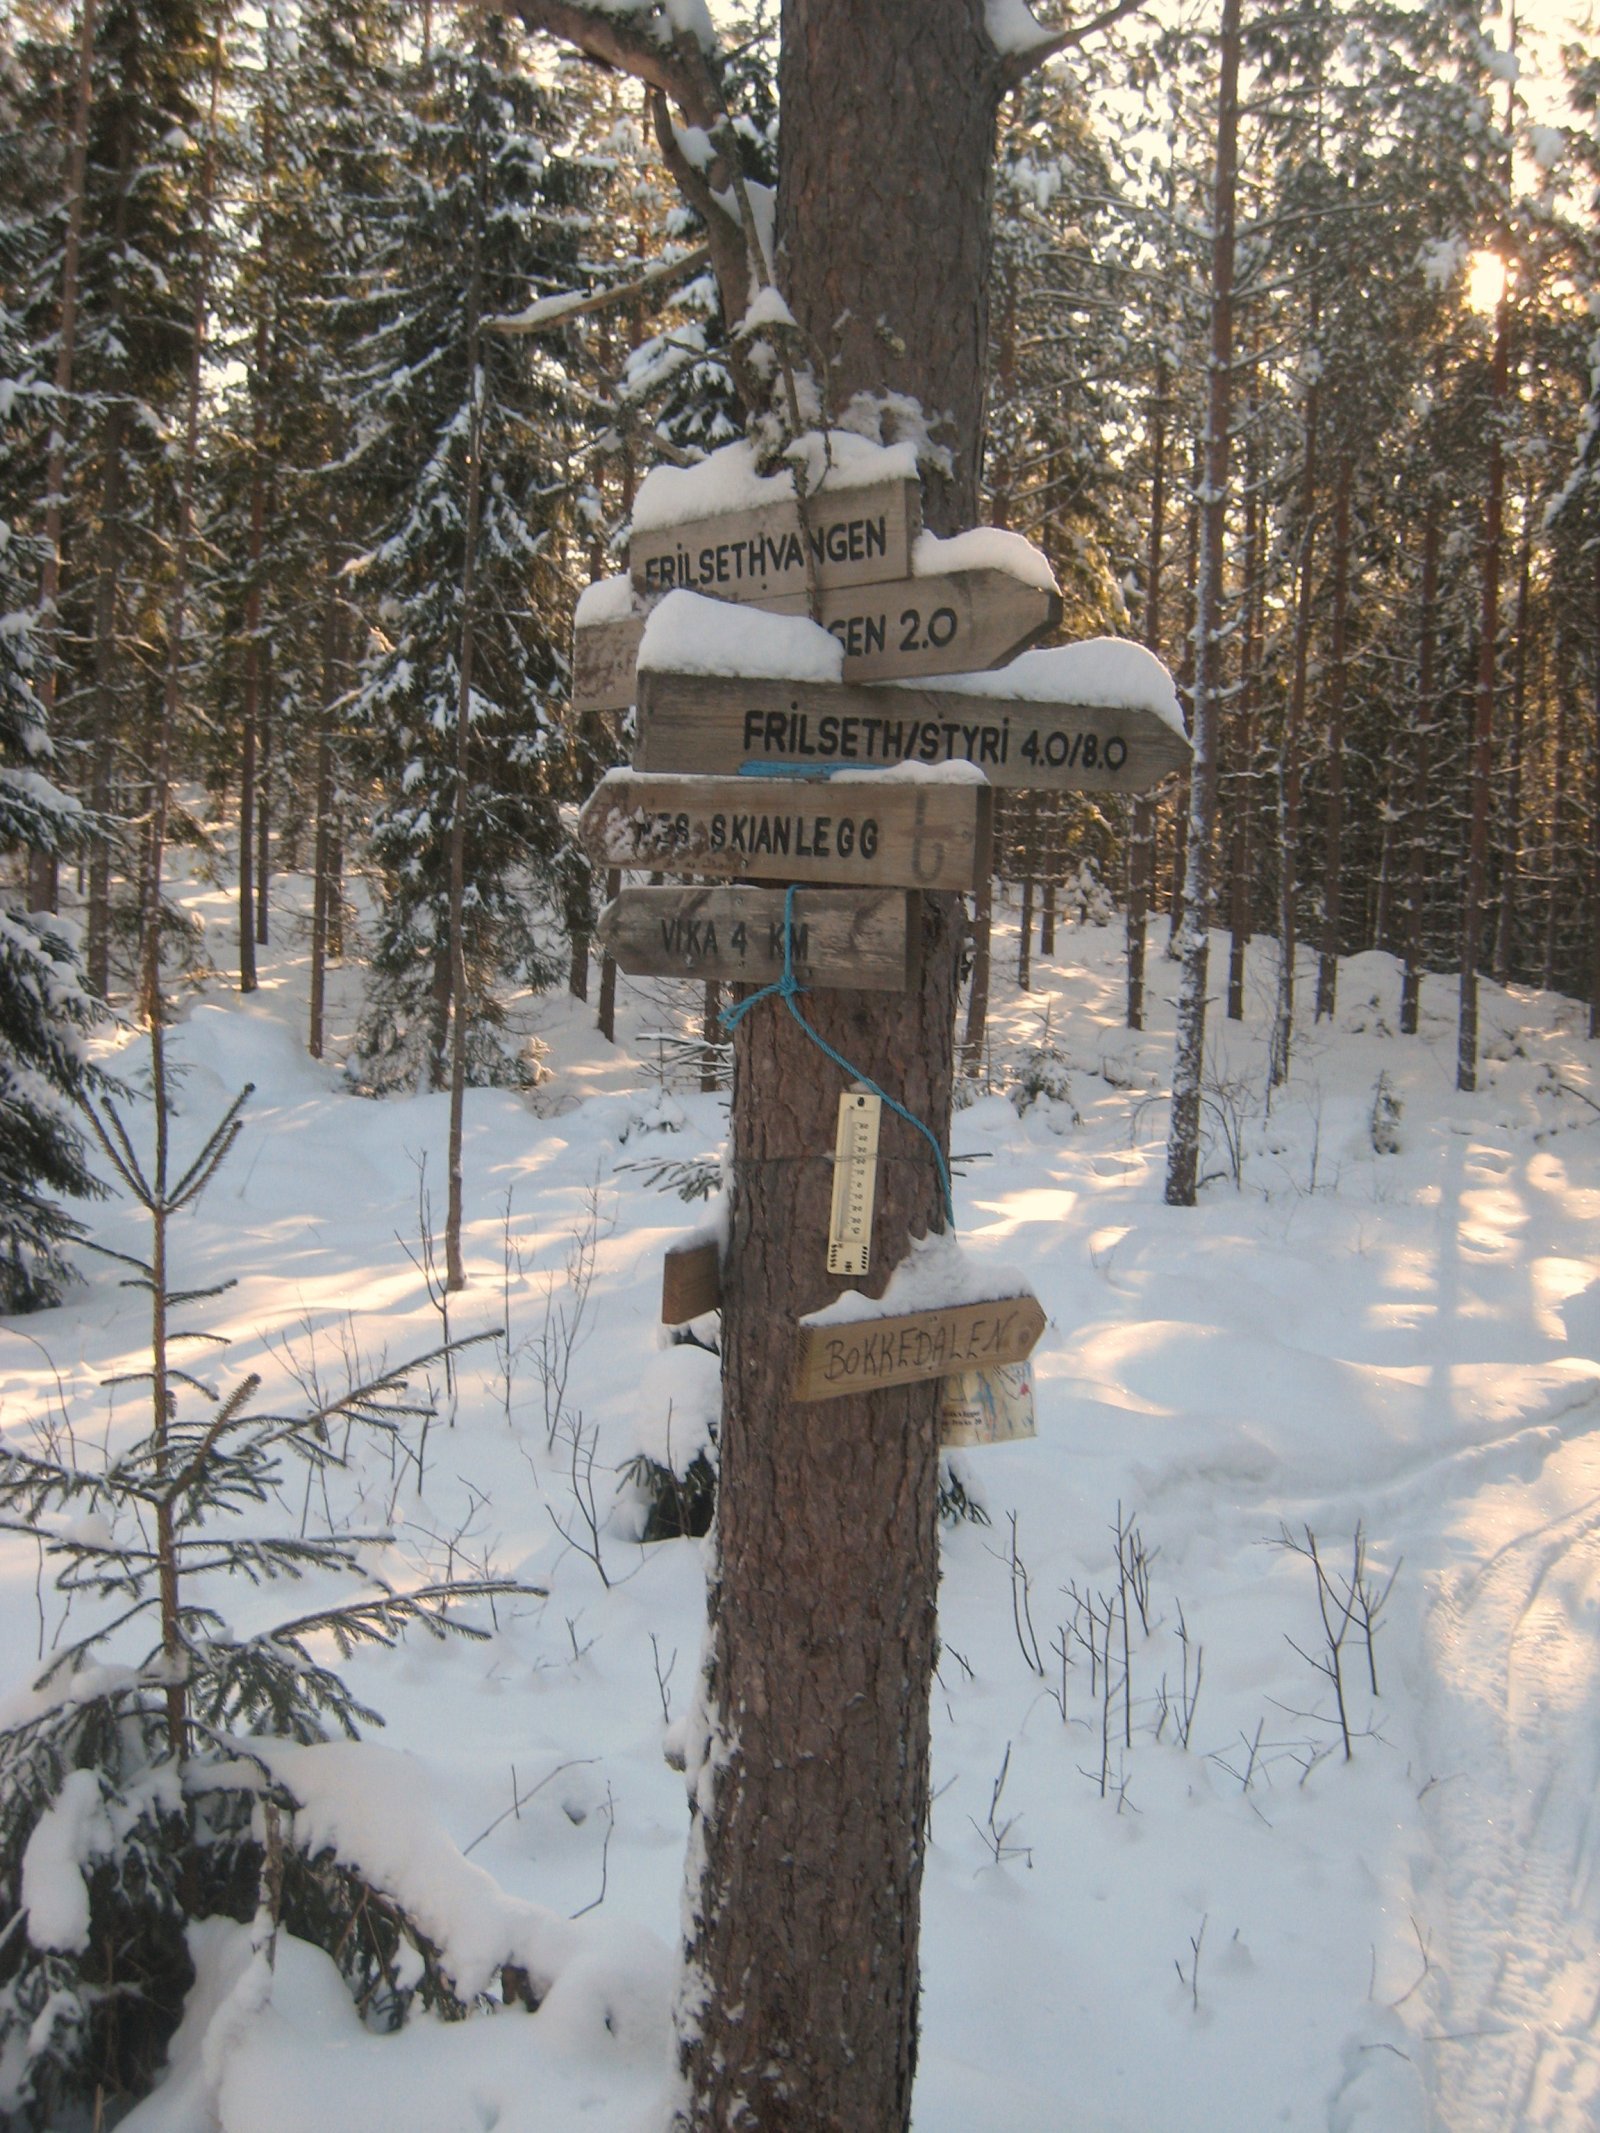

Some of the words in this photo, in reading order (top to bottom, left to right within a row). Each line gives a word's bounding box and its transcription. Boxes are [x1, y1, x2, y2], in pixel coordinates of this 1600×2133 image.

[900, 607, 957, 652] 2.0
[1021, 730, 1128, 771] 4.0/8.0
[661, 918, 719, 956] VIKA
[731, 920, 748, 957] 4
[824, 1310, 1020, 1380] BOKKEDALEN
